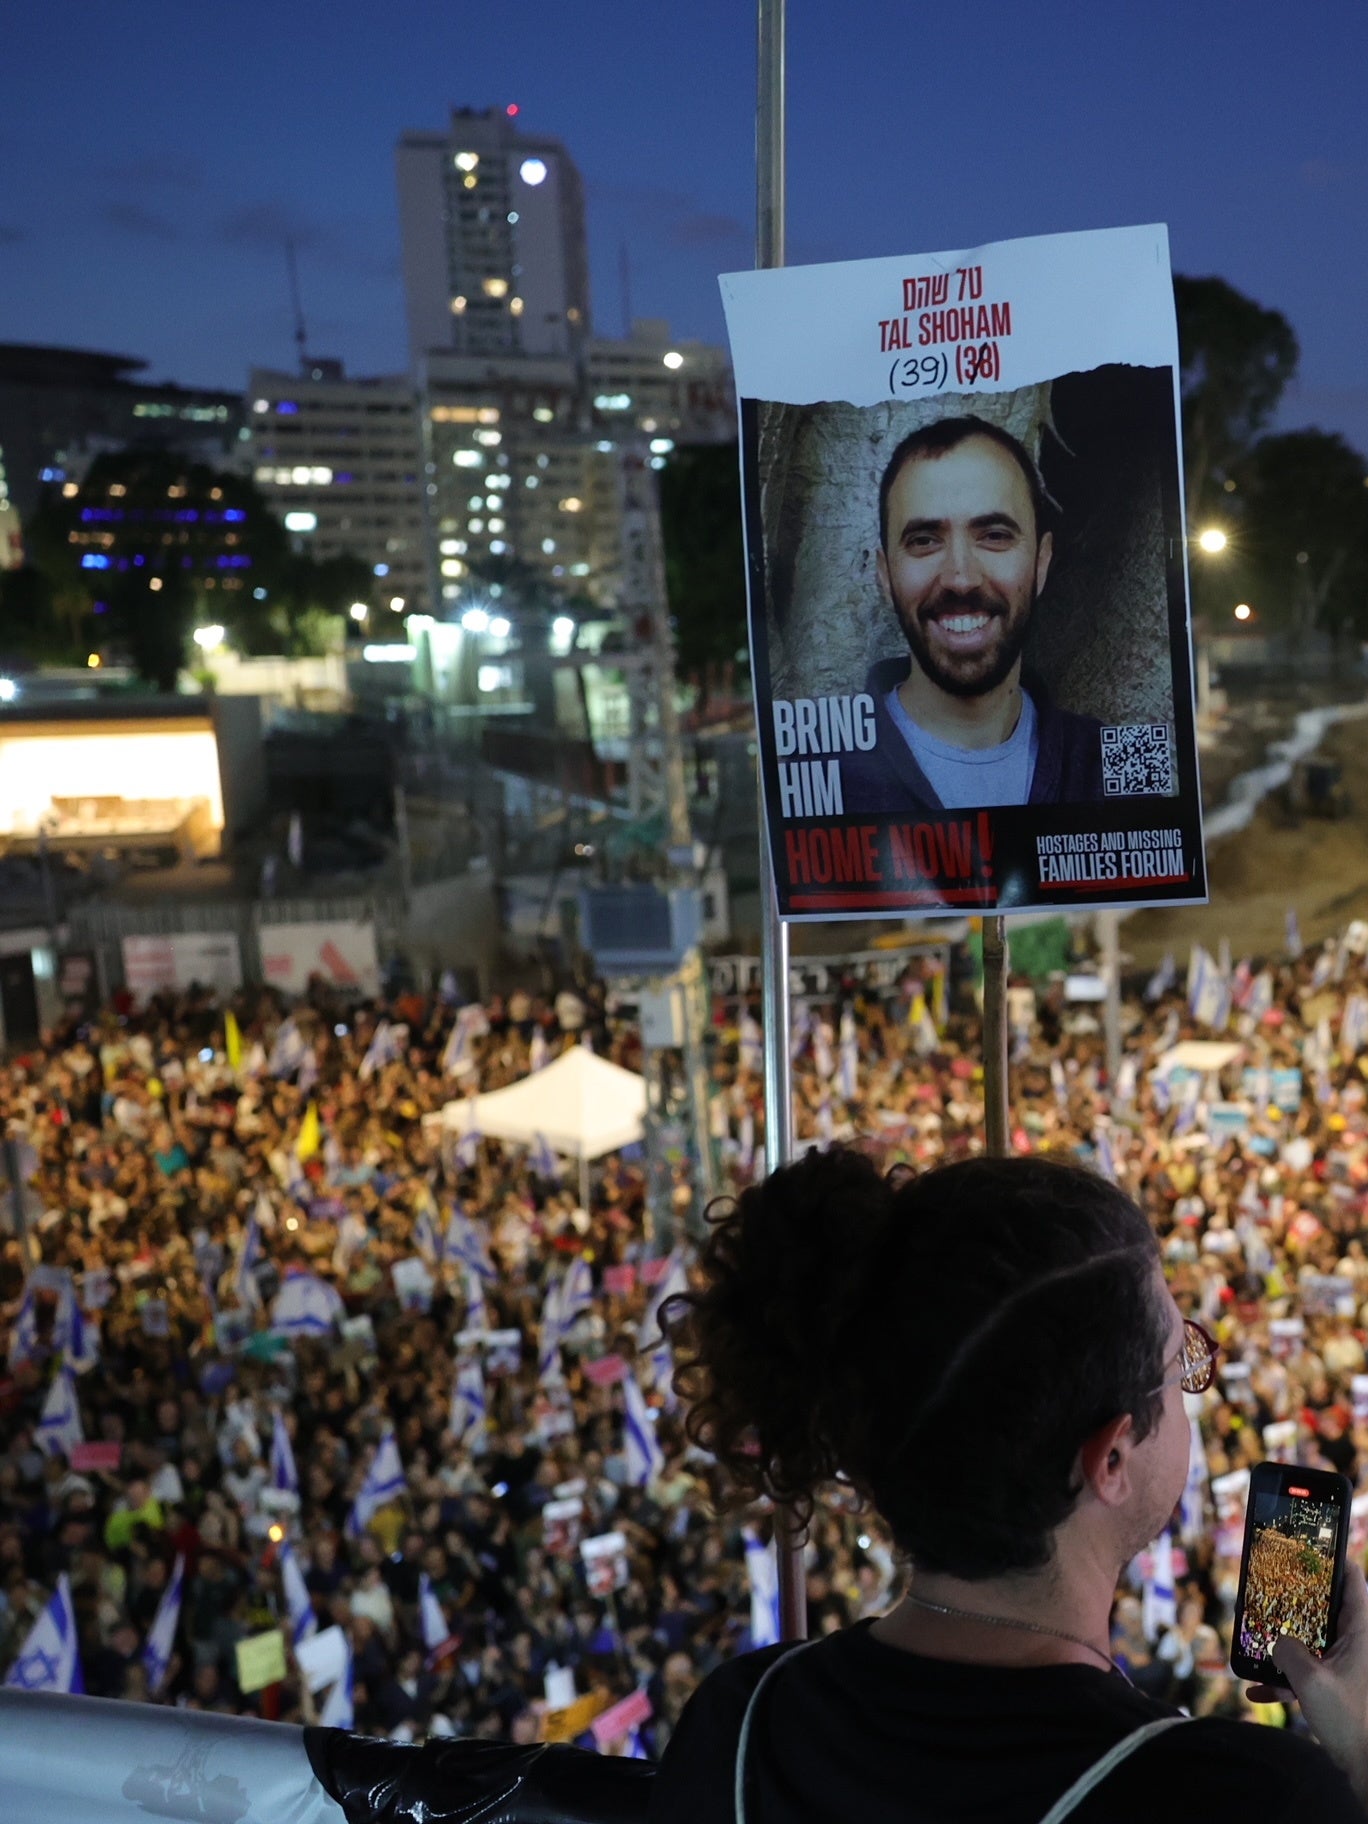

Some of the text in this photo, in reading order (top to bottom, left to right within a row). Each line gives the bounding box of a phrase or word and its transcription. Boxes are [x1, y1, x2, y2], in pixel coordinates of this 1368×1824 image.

[902, 265, 983, 312] טל שהם
[878, 301, 1012, 353] TAL SHOHAM
[889, 352, 948, 395] (39)
[955, 341, 1001, 385] (38)
[772, 693, 877, 757] BRING
[777, 759, 844, 818] HIM
[785, 825, 883, 885] HOME
[1036, 828, 1183, 855] HOSTAGES AND MISSING
[1039, 848, 1185, 883] FAMILIES FORUM
